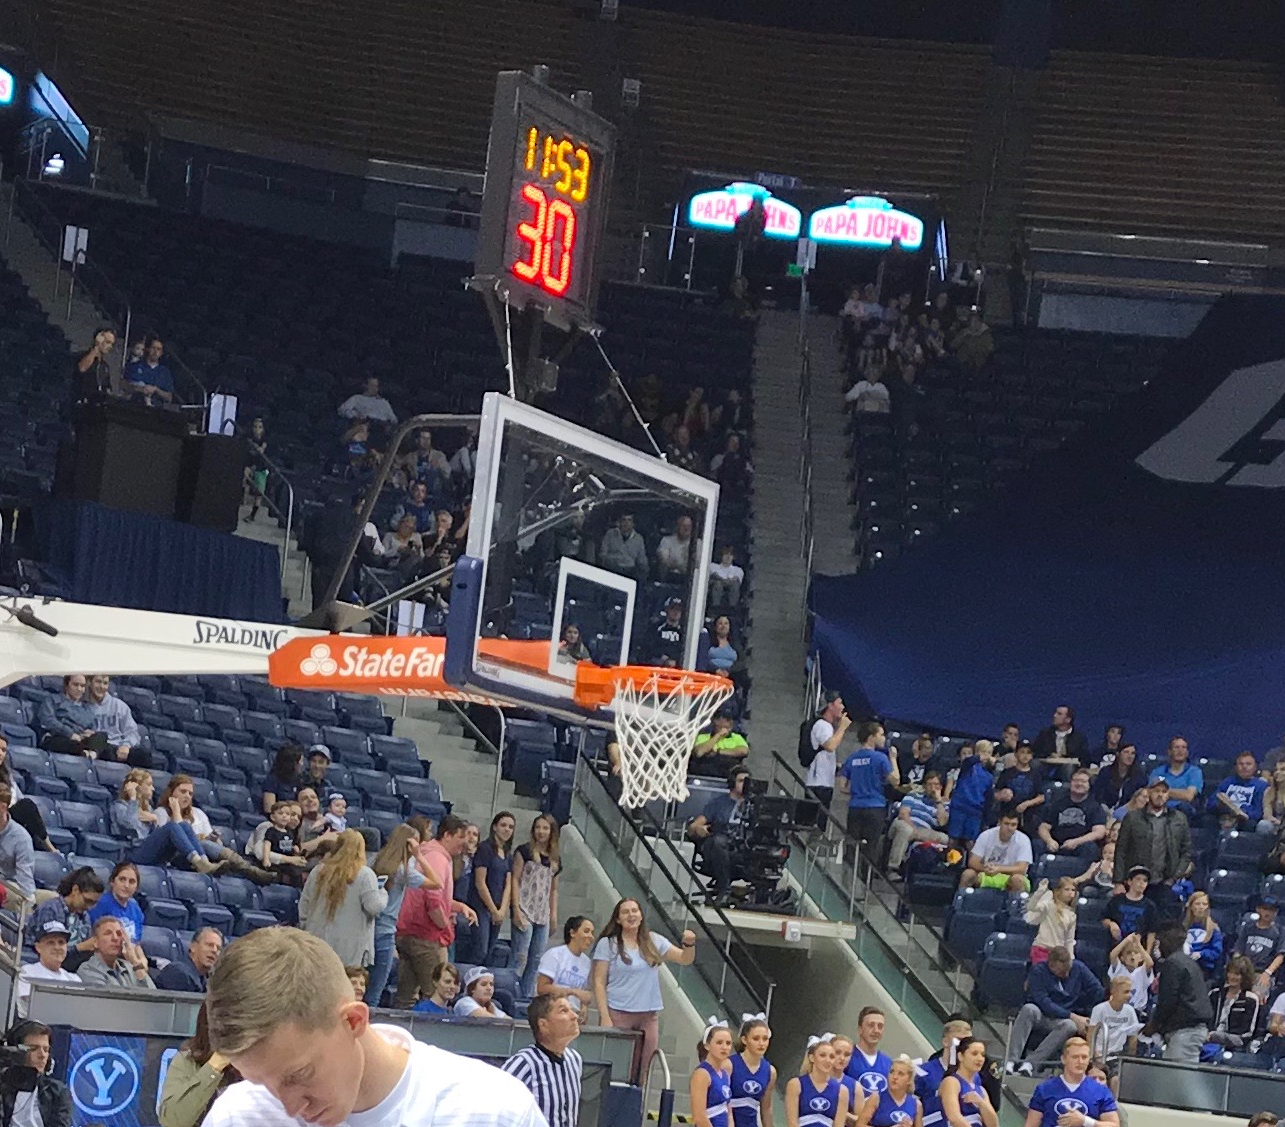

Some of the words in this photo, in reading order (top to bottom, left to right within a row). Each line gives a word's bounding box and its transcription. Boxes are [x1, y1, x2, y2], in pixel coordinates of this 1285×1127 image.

[525, 126, 591, 202] 11:53
[515, 183, 577, 297] 30
[338, 644, 445, 679] StateFar
